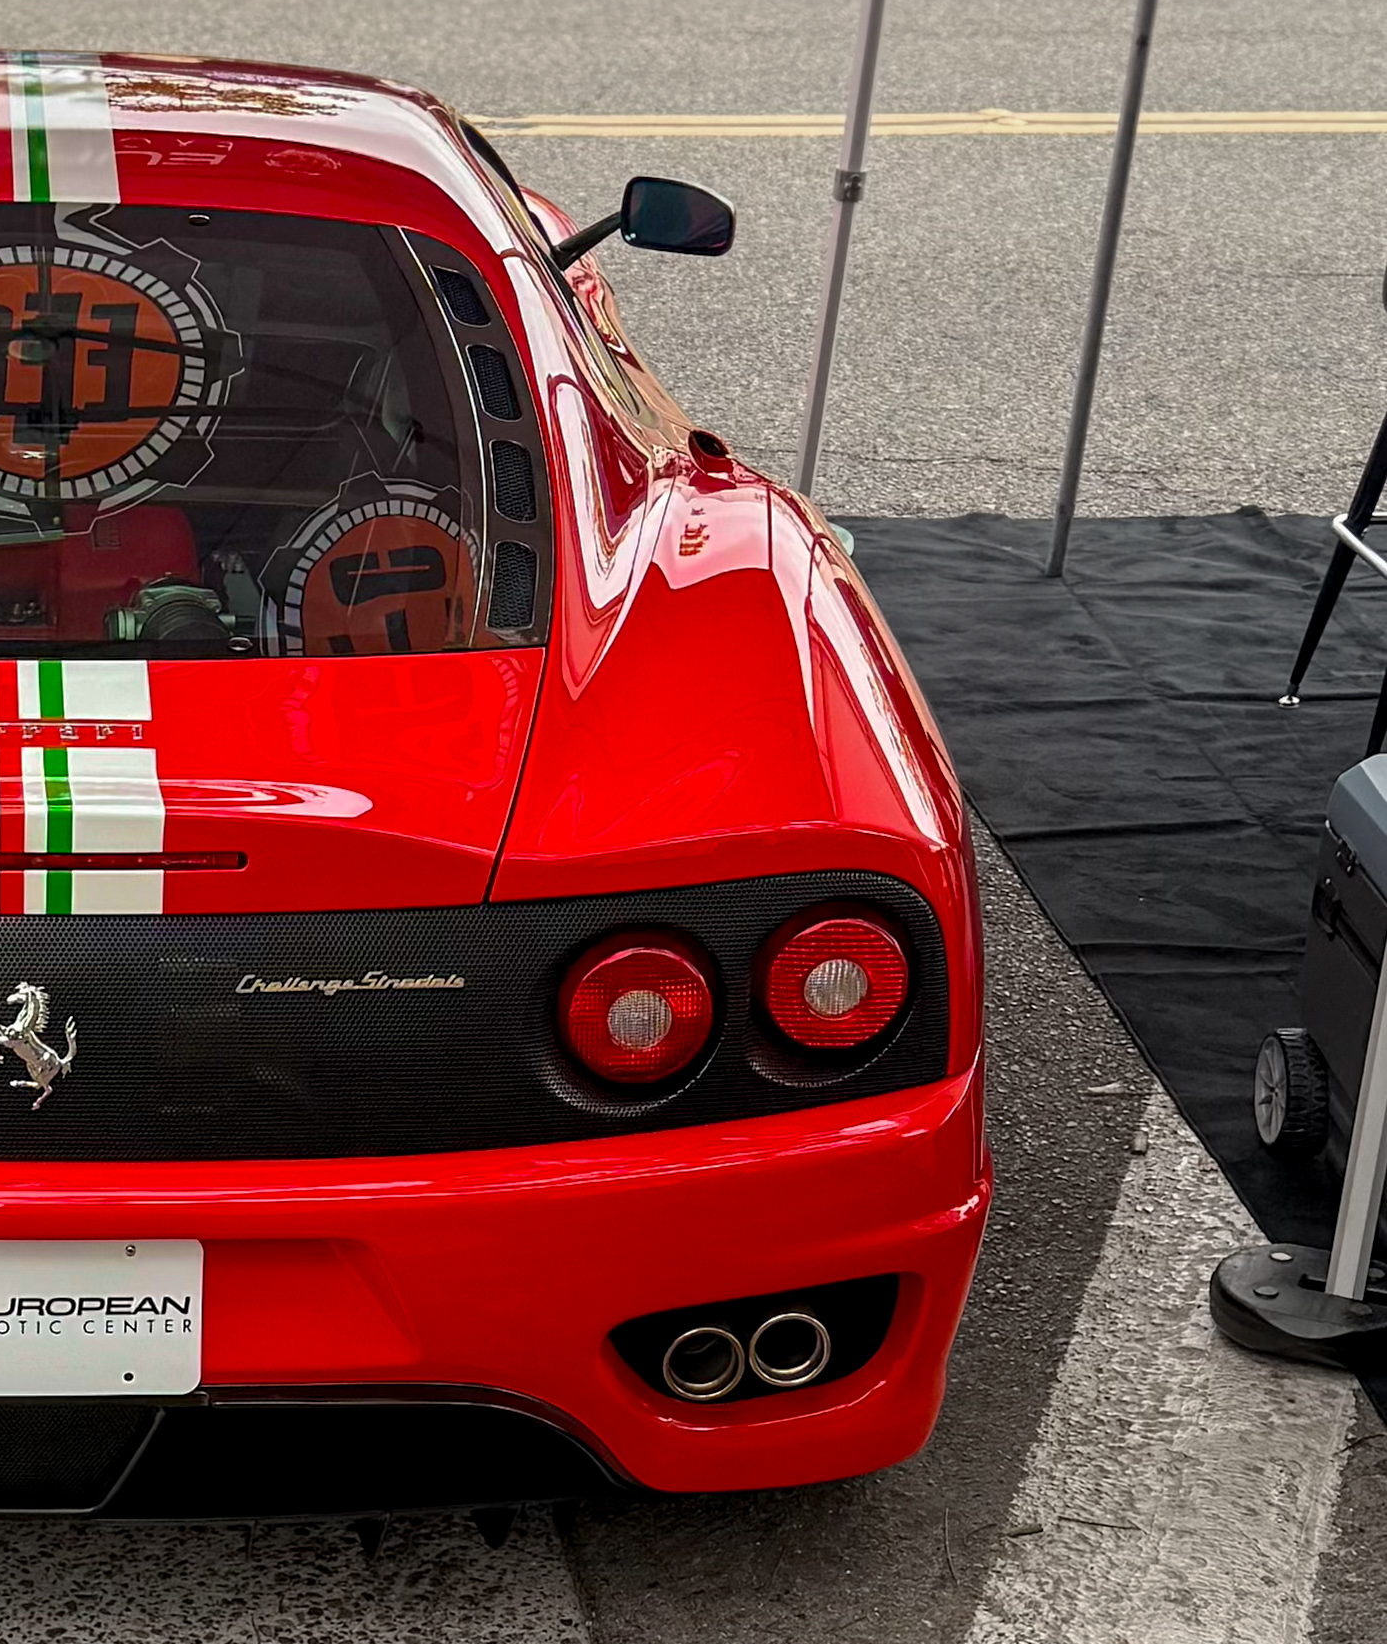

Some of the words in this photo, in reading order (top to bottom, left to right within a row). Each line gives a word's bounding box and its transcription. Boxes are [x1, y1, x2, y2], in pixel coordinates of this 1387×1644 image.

[235, 974, 355, 996] Challenge
[361, 970, 466, 991] Stradale
[83, 1318, 194, 1335] CENTER
